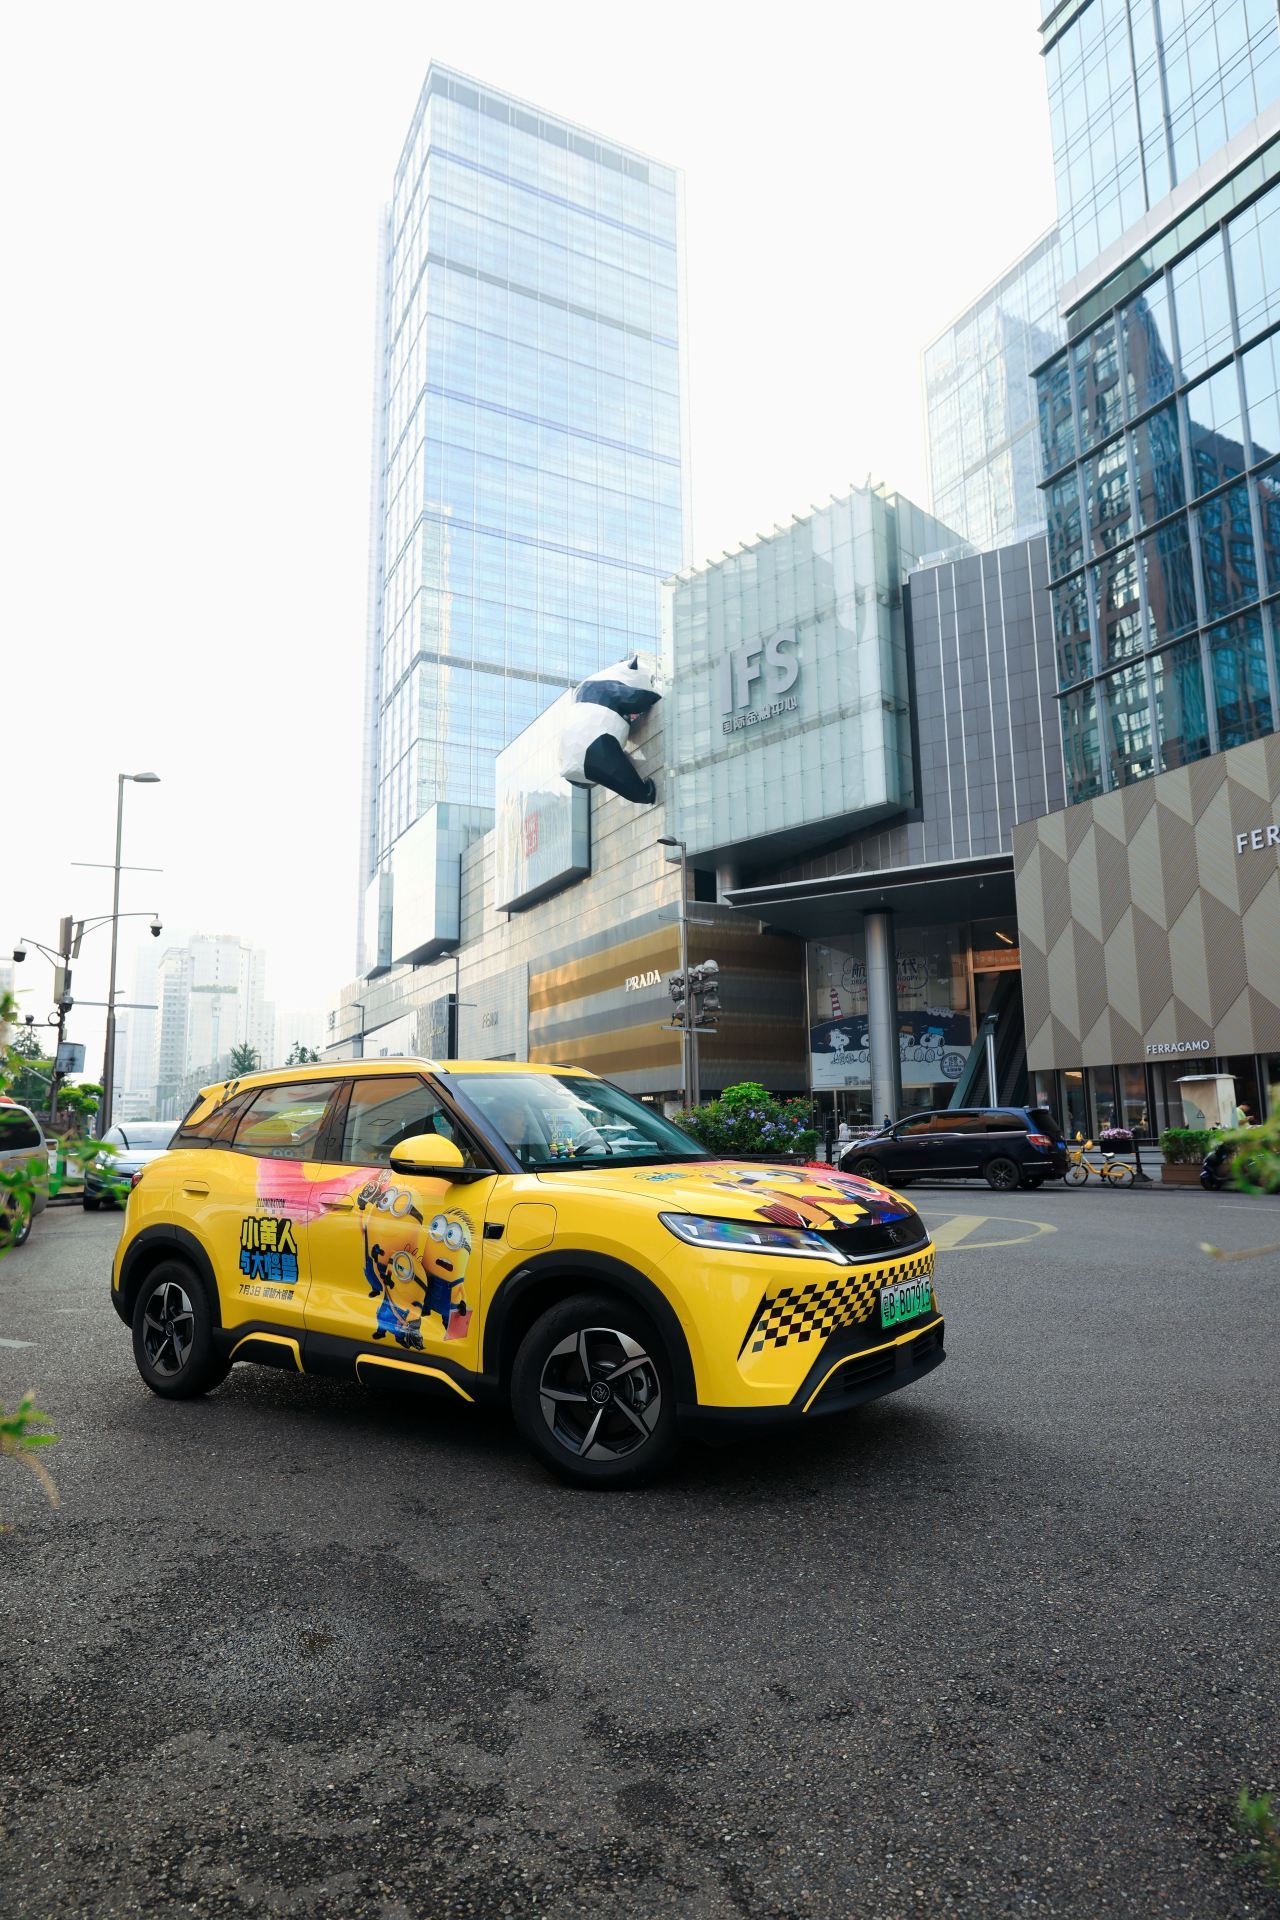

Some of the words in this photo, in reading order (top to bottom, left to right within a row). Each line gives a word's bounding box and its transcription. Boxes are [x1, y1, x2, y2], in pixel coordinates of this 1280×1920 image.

[720, 627, 800, 716] IFS
[722, 696, 798, 735] 国际金融中心
[1236, 824, 1280, 854] FER
[625, 969, 661, 993] PRADA
[1146, 1040, 1210, 1054] FERRAGAMO
[241, 1216, 297, 1254] 小黄人
[240, 1249, 298, 1284] 与大怪兽
